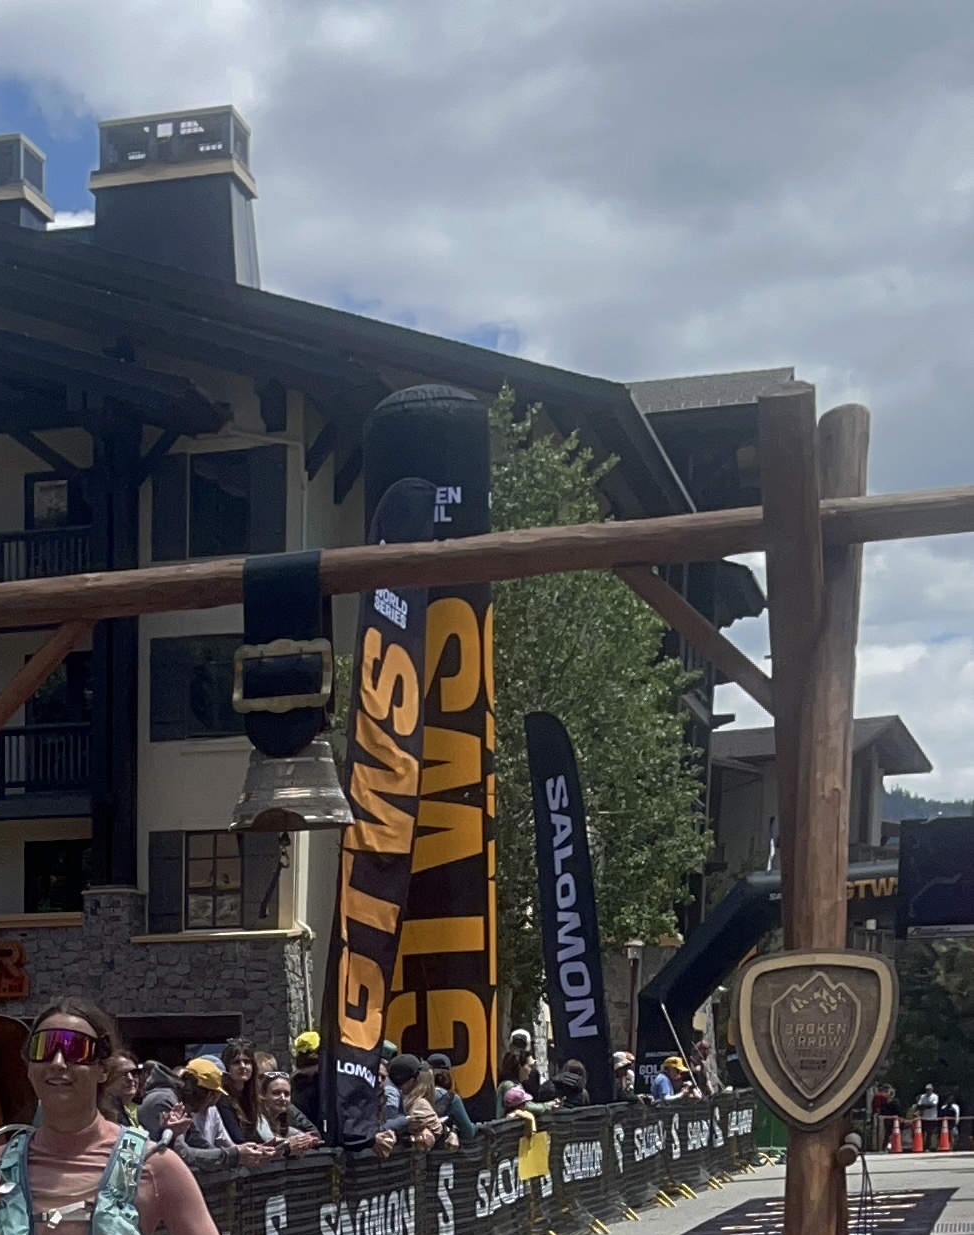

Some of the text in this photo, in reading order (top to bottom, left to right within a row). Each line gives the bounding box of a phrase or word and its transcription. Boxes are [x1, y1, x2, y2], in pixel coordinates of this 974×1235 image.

[373, 596, 407, 630] SERIES
[338, 626, 421, 1052] GTWS
[846, 876, 898, 901] GTW
[545, 774, 599, 1038] SALOMON
[785, 1022, 847, 1035] BROKEN
[787, 1035, 842, 1047] ARROW
[337, 1060, 376, 1088] LOMON
